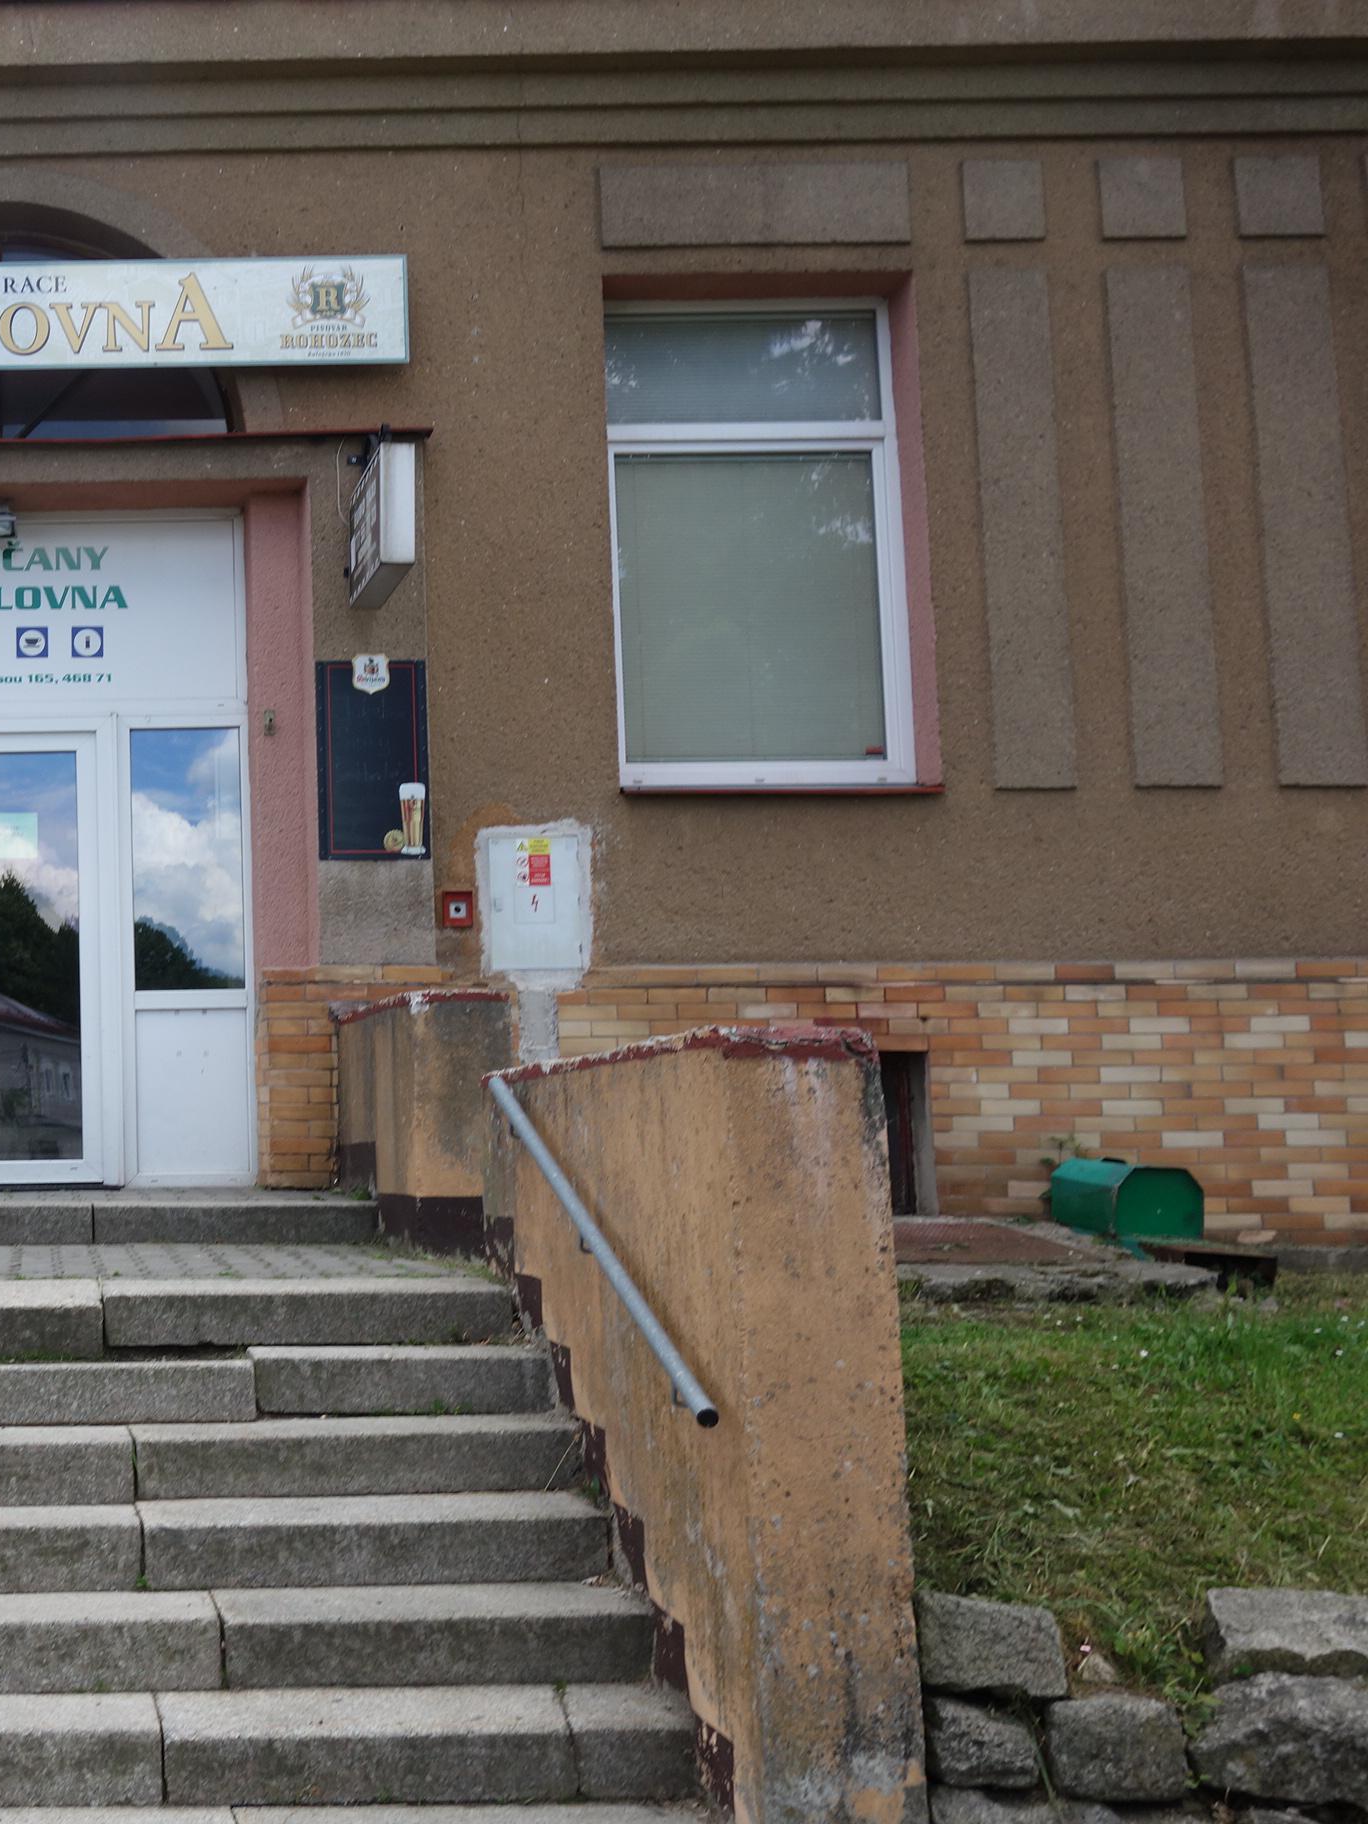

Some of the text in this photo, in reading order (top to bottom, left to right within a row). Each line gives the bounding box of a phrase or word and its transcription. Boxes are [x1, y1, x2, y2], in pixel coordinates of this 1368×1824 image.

[316, 287, 341, 311] R
[279, 332, 378, 349] ROHOZEC
[27, 674, 59, 684] 165,
[62, 673, 92, 683] 468
[95, 673, 112, 683] 71
